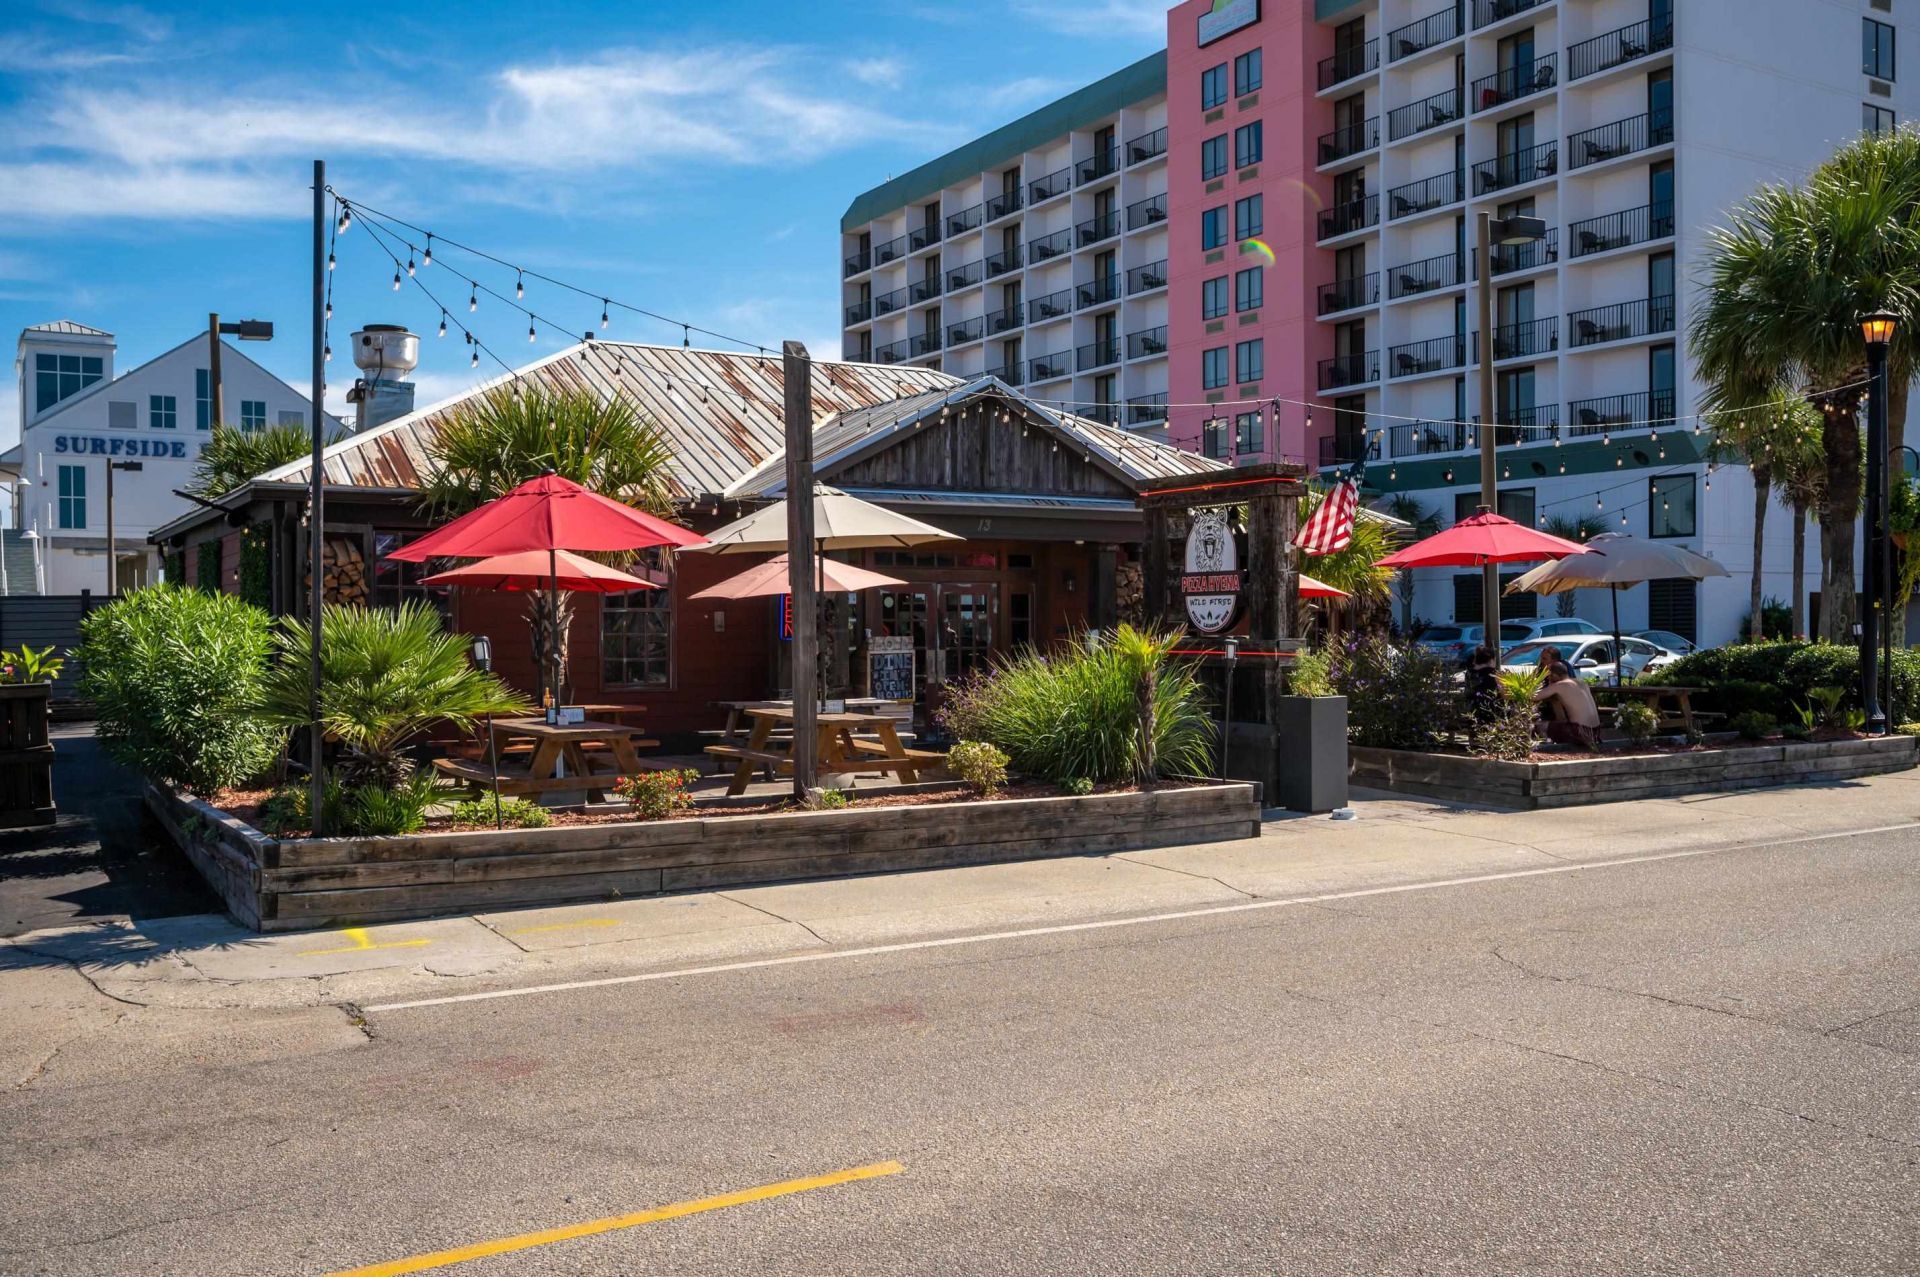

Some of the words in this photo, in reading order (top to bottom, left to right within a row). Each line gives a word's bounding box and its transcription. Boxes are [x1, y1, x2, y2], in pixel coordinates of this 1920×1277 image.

[55, 436, 186, 458] SURFSIDE
[1209, 598, 1232, 606] FIRED
[873, 654, 912, 670] DINE
[875, 681, 906, 692] OPEN
